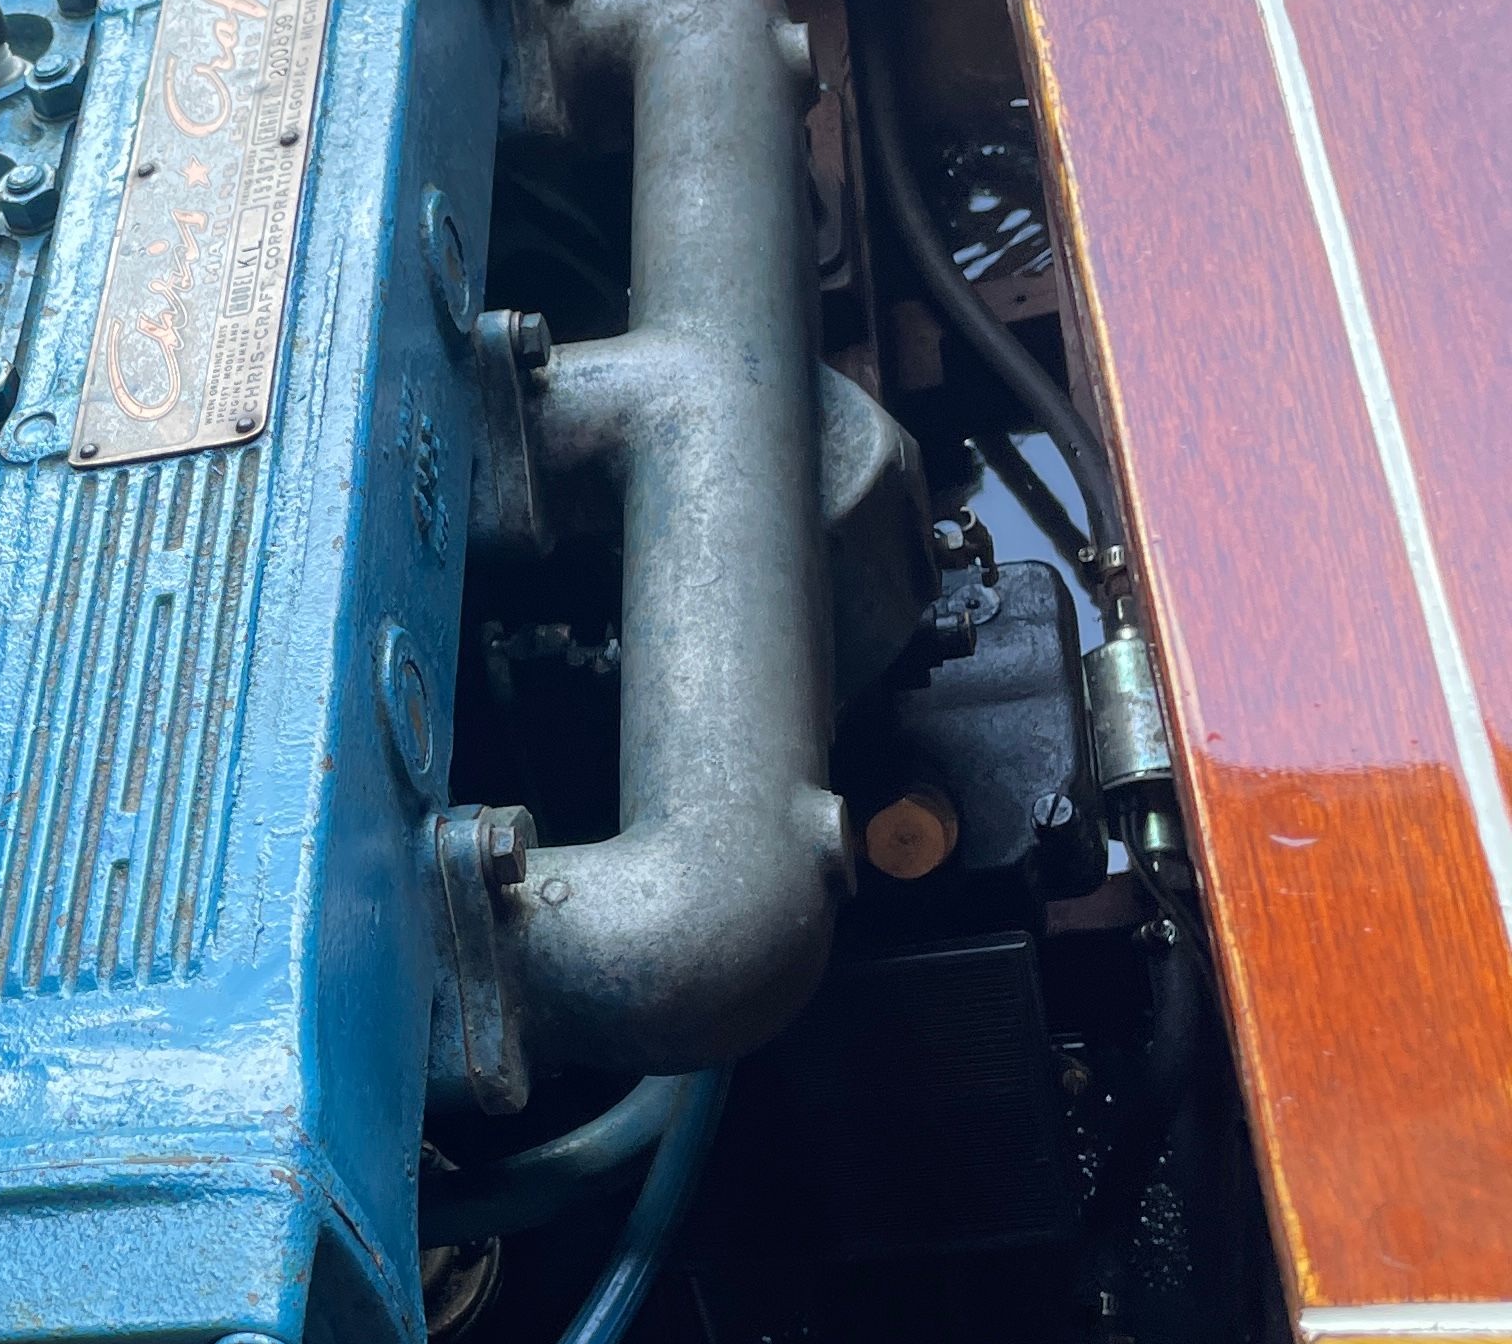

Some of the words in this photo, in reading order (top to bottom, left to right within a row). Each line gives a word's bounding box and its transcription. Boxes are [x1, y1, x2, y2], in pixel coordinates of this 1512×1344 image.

[256, 99, 281, 141] ENGINE
[201, 161, 240, 285] MARINE
[225, 30, 263, 144] ENGINE
[228, 271, 254, 313] MODEL
[241, 280, 276, 413] CHRIS-CRAFT
[262, 145, 296, 271] CORPORATION
[108, 208, 208, 421] Chris
[228, 321, 239, 343] AND
[216, 323, 227, 349] PARTS
[208, 351, 223, 396] ORDERING
[222, 347, 235, 379] MODEL
[227, 379, 242, 422] ENGINE
[235, 327, 250, 372] NUMBER
[203, 398, 216, 425] WHEN
[215, 385, 229, 423] SPECIFY
